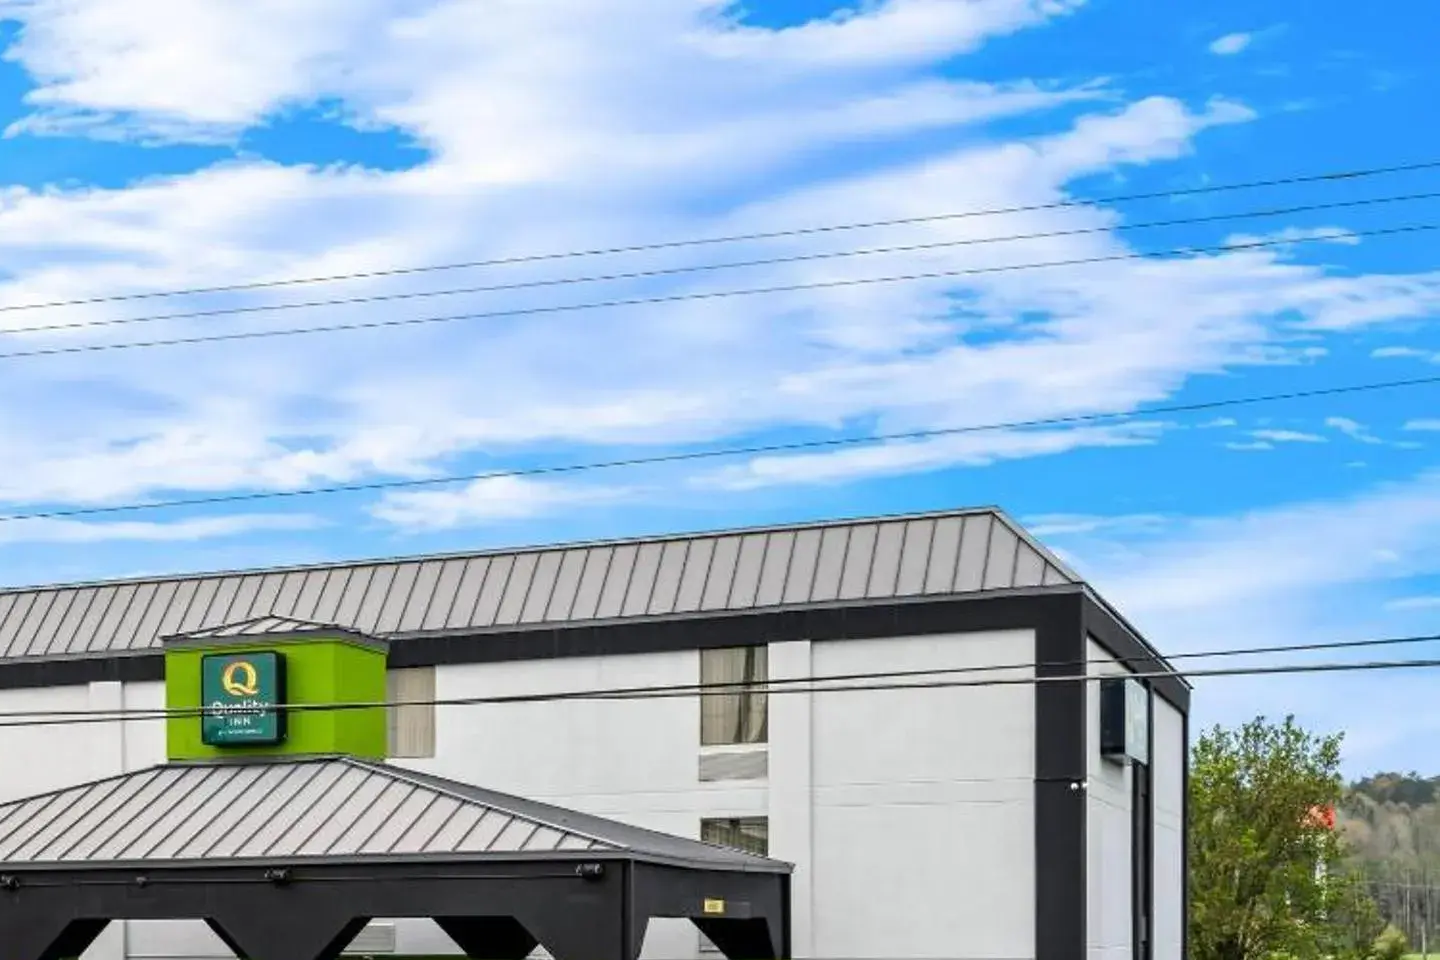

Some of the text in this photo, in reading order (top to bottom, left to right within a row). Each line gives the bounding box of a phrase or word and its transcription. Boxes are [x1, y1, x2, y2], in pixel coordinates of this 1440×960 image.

[222, 661, 259, 696] Q
[212, 700, 269, 719] Quality
[229, 717, 251, 727] INN
